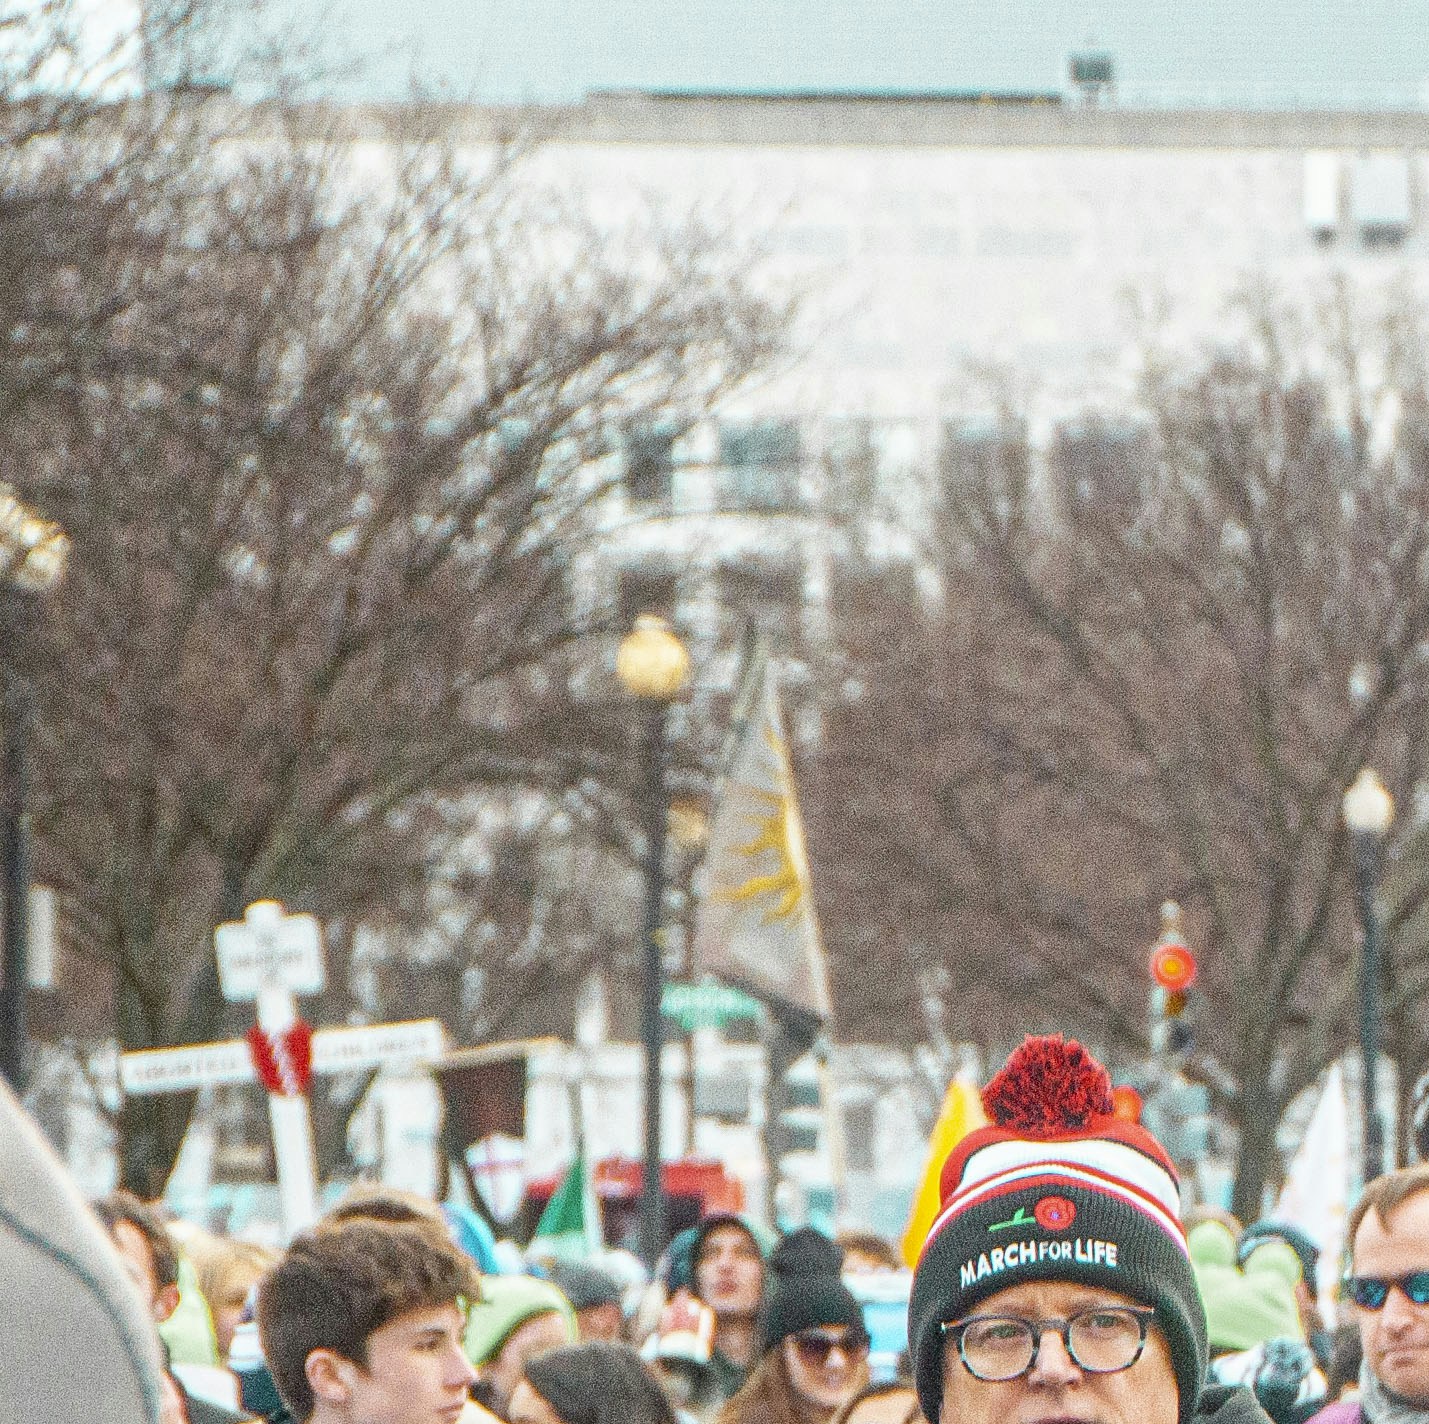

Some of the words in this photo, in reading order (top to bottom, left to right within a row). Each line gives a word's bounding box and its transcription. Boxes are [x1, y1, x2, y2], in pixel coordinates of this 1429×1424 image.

[960, 1239, 1036, 1288] MARCH
[1039, 1240, 1072, 1260] FOR
[1075, 1237, 1118, 1267] LIFE
